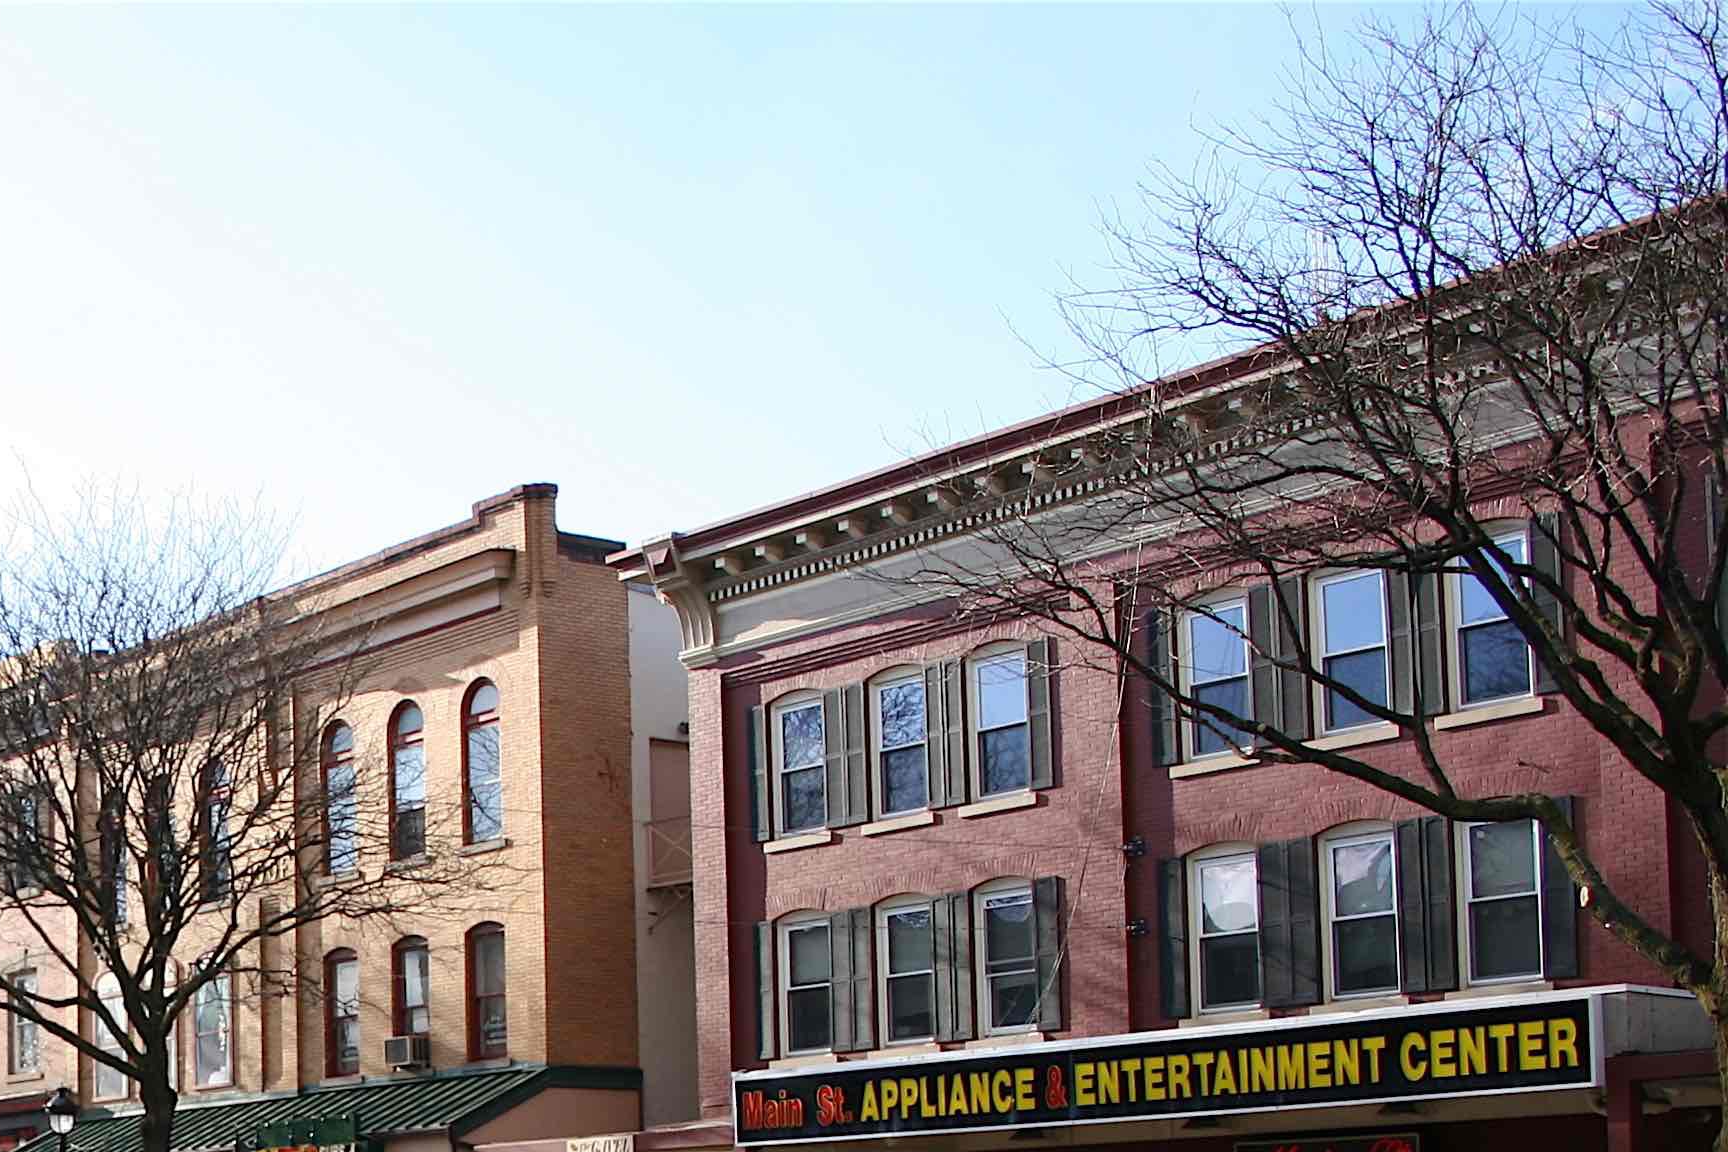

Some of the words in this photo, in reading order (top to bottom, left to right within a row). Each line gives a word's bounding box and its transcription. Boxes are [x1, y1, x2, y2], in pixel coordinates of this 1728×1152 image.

[742, 1090, 804, 1130] Main
[816, 1085, 854, 1126] St.
[860, 1068, 1036, 1122] APPLIANCE
[1045, 1065, 1068, 1109] &
[1074, 1036, 1386, 1106] ENTERTAINMENT
[1399, 1017, 1579, 1082] CENTER
